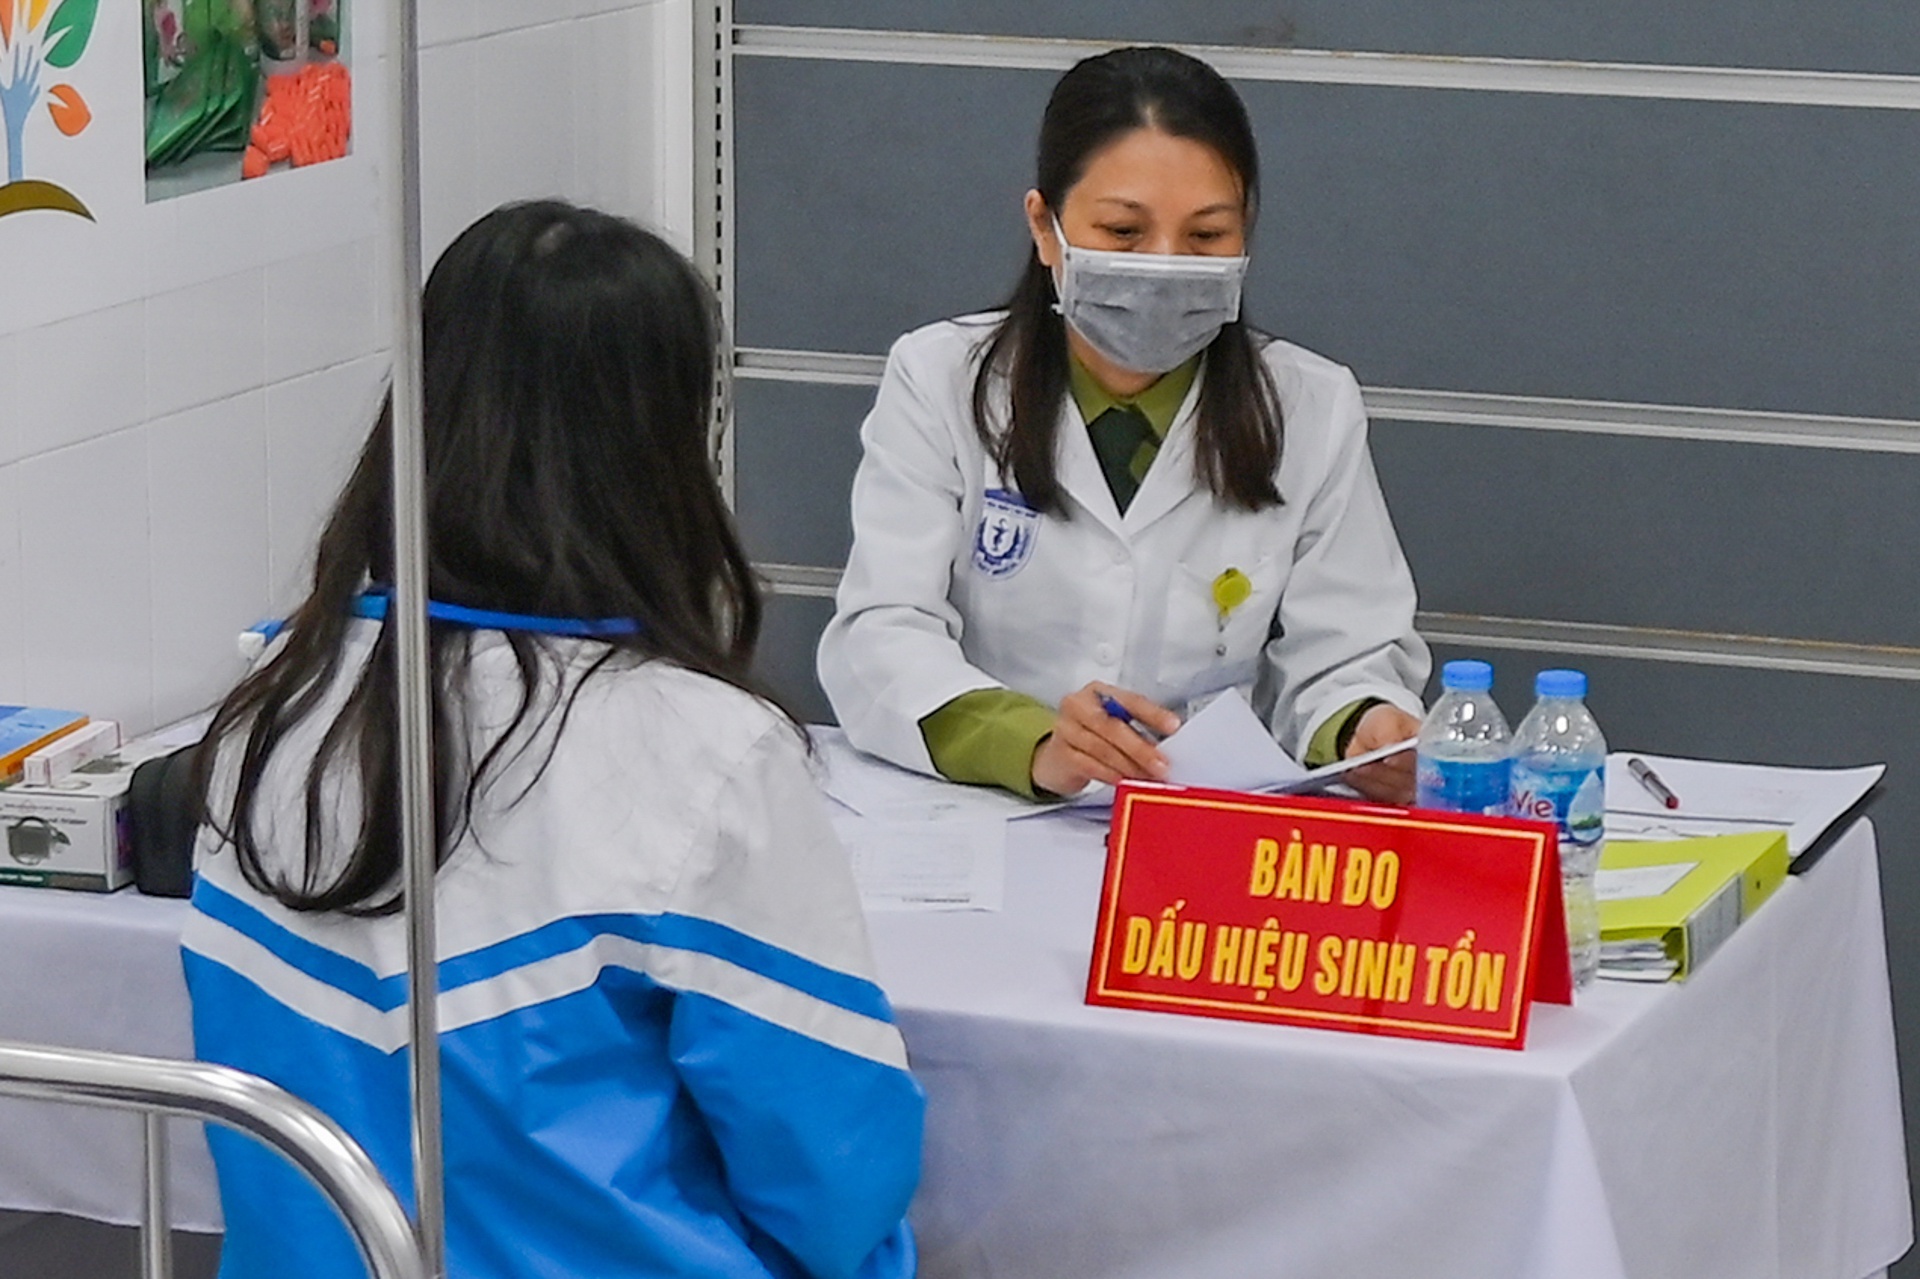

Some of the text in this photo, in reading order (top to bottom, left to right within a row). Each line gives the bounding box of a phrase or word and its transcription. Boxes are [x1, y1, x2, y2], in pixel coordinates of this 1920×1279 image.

[1249, 828, 1401, 911] BÀN ĐO
[1121, 898, 1507, 1013] DẤU HIỆU SINH TỒN
